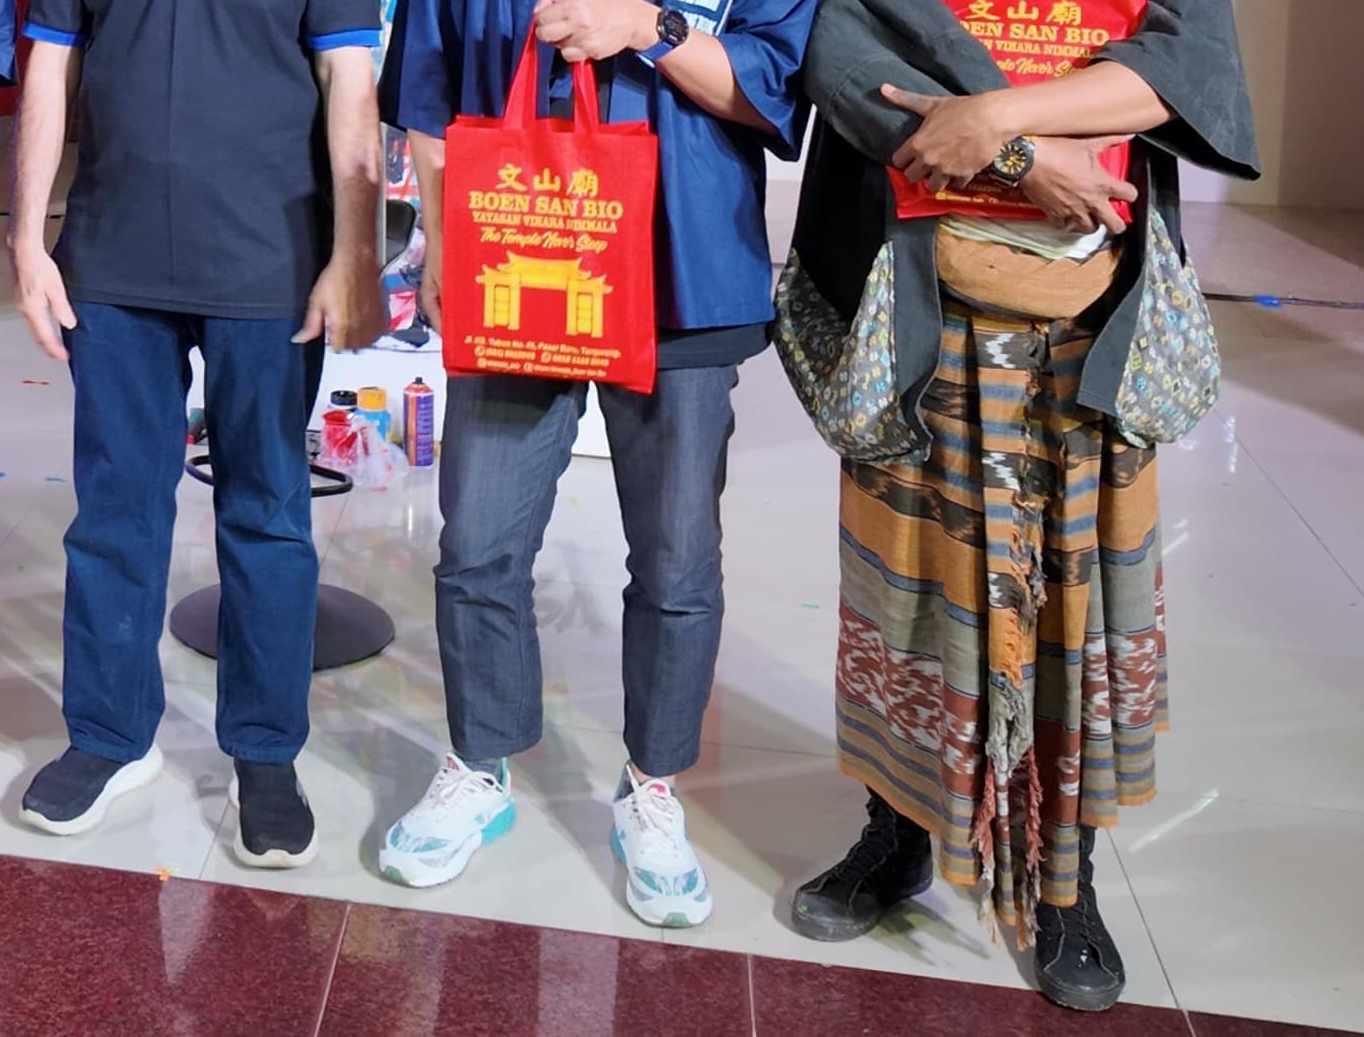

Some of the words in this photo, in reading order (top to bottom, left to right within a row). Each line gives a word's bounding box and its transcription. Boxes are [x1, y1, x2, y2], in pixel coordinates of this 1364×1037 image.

[1010, 25, 1058, 40] SAN
[1066, 28, 1108, 46] BIO
[469, 191, 530, 210] BOEN
[536, 195, 578, 215] SAN
[583, 200, 624, 219] BIO
